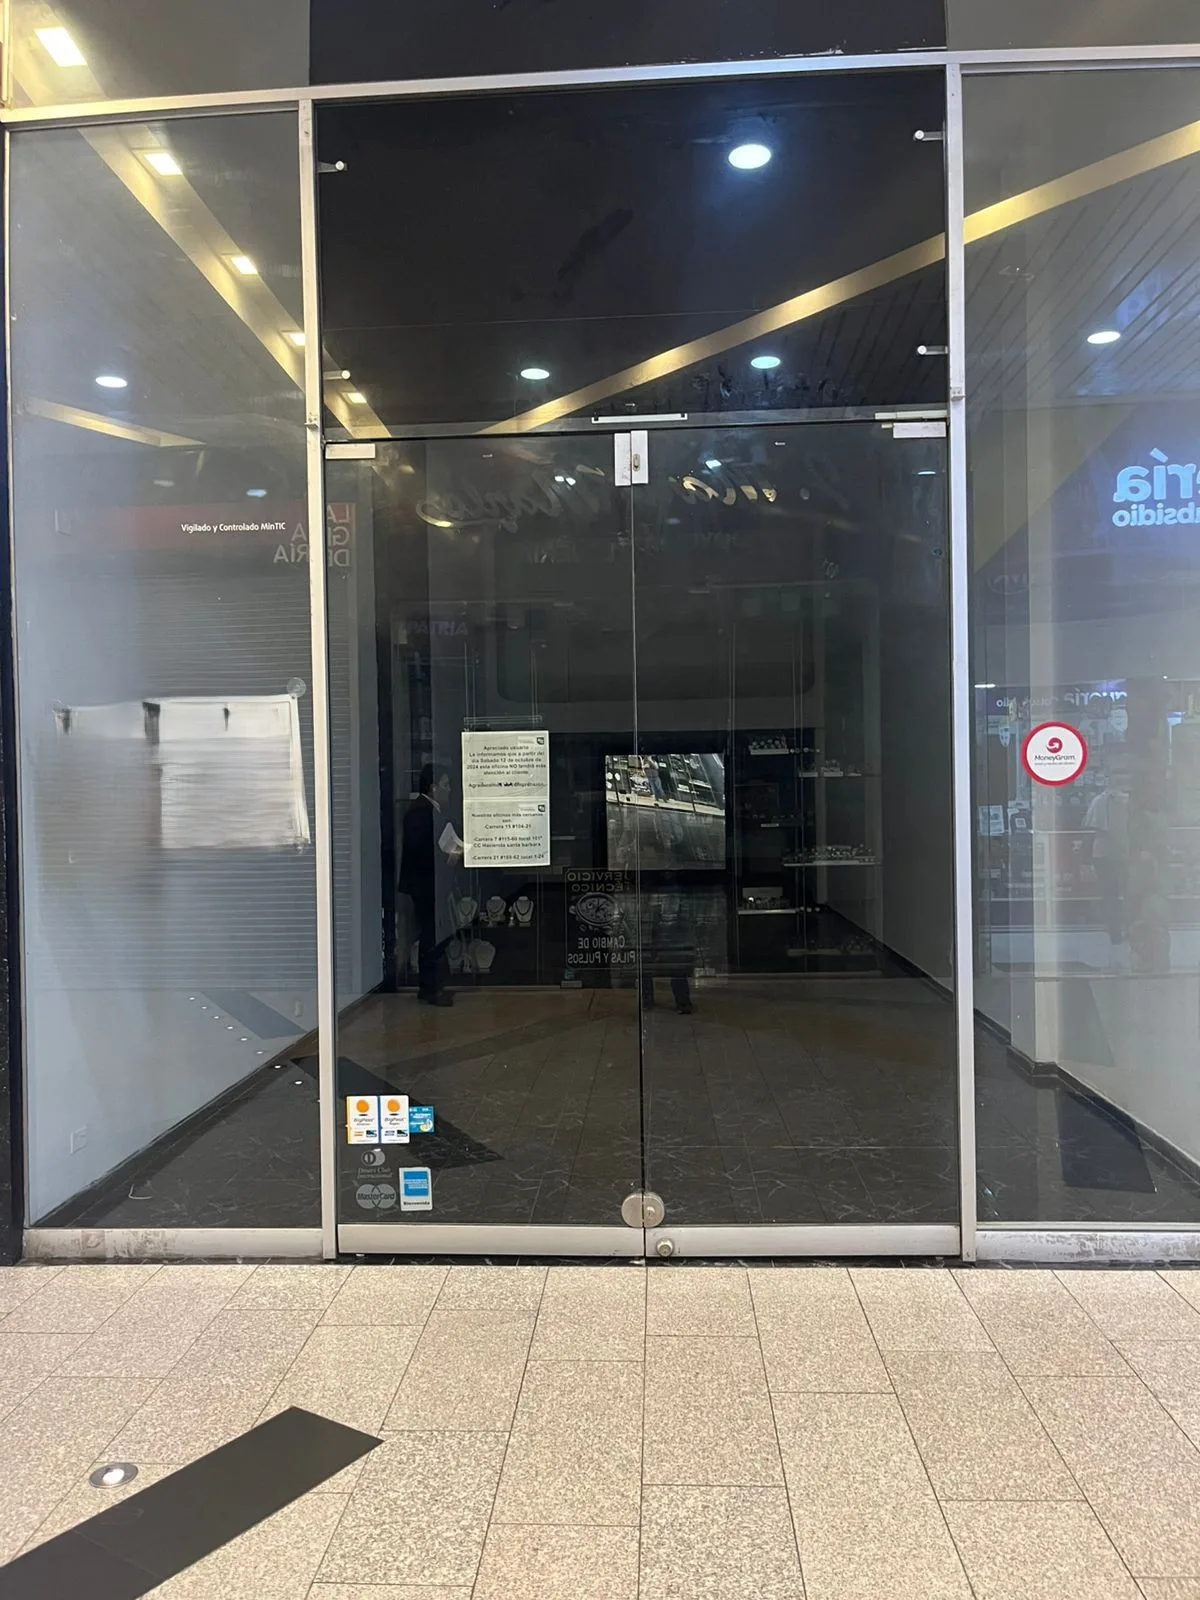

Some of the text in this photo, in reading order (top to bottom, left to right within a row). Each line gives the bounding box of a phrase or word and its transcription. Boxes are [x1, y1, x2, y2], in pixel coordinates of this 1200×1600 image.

[181, 522, 286, 534] Vigilado y Controlado MinTIC
[1034, 755, 1076, 763] MoneyGram
[357, 1192, 396, 1201] MasterCard
